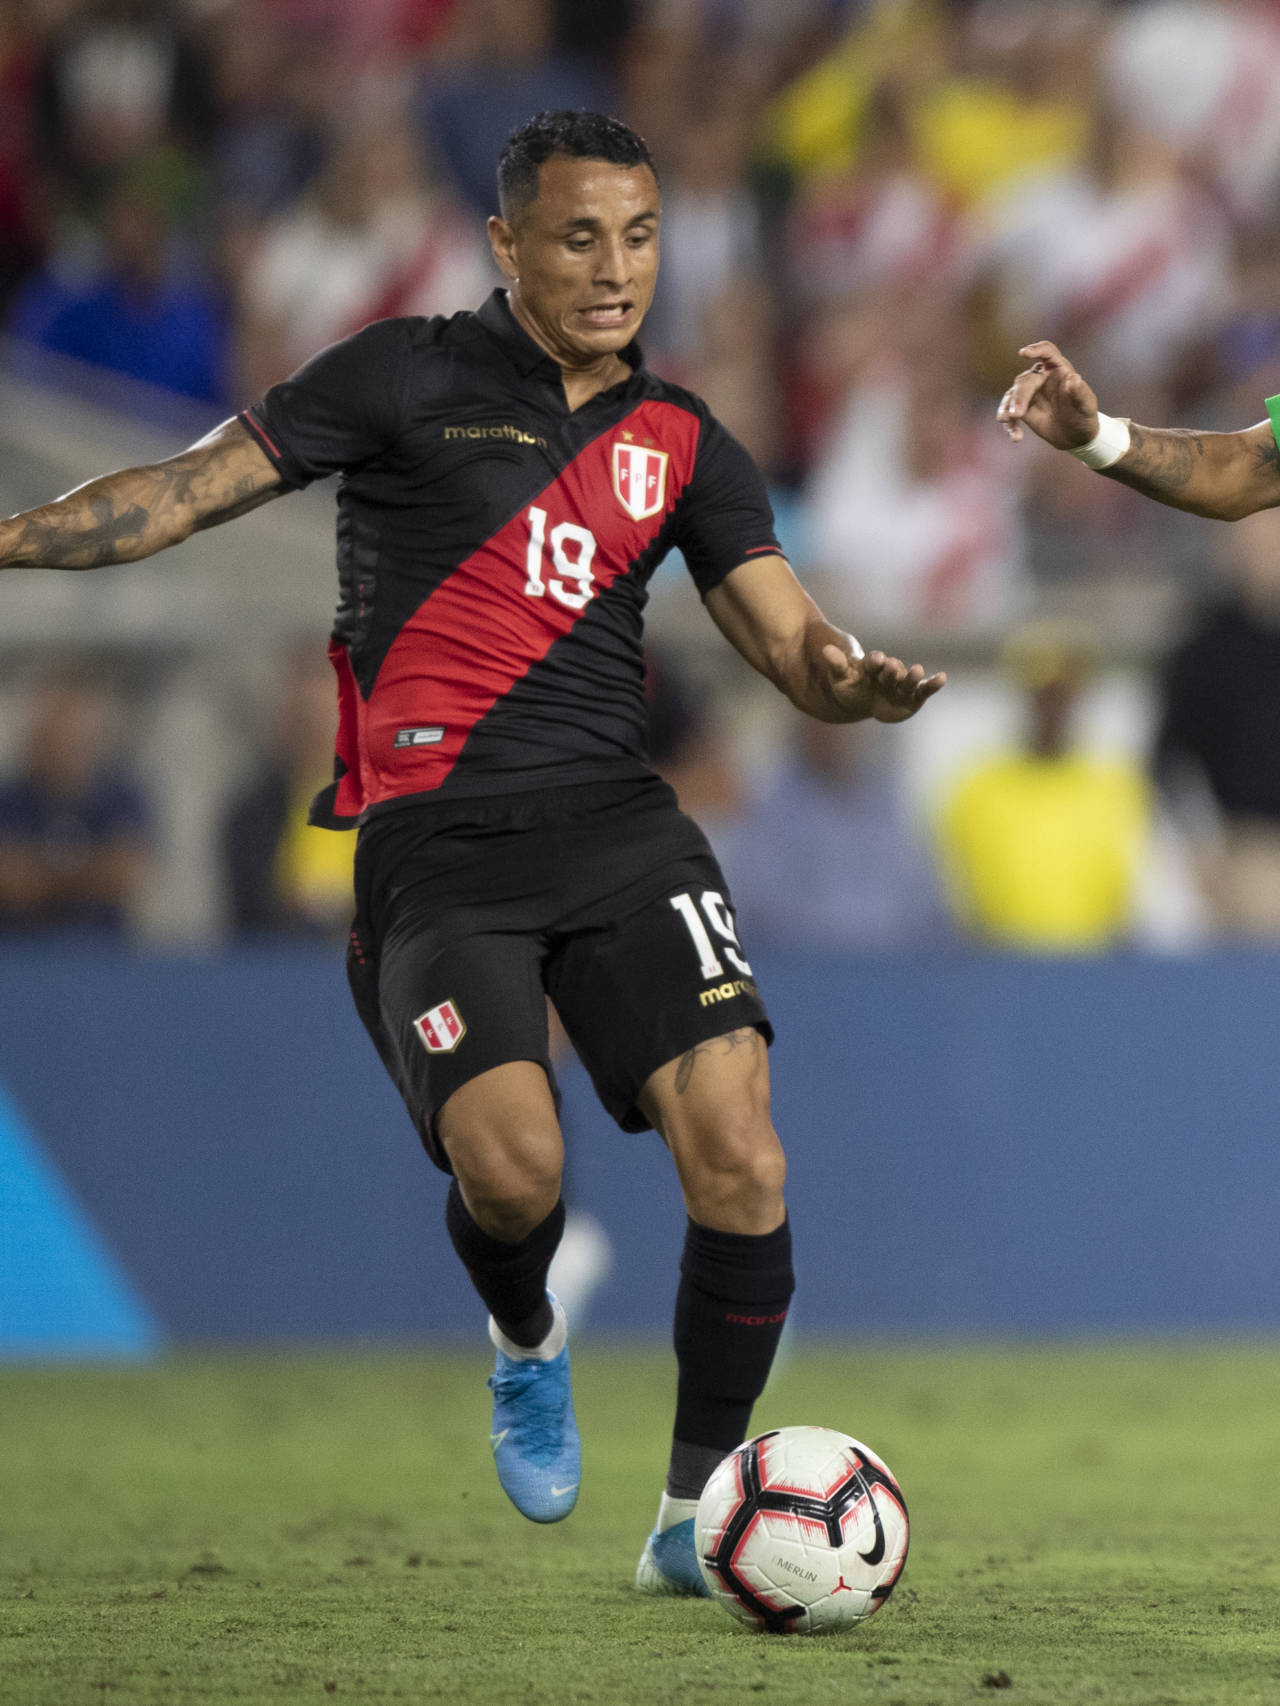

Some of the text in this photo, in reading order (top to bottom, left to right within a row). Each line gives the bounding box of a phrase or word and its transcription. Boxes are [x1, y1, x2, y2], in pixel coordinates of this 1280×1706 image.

[443, 424, 548, 449] marathon
[524, 505, 598, 610] 19
[669, 890, 753, 980] 19
[699, 980, 757, 1008] mara
[776, 1557, 818, 1583] MERLIN
